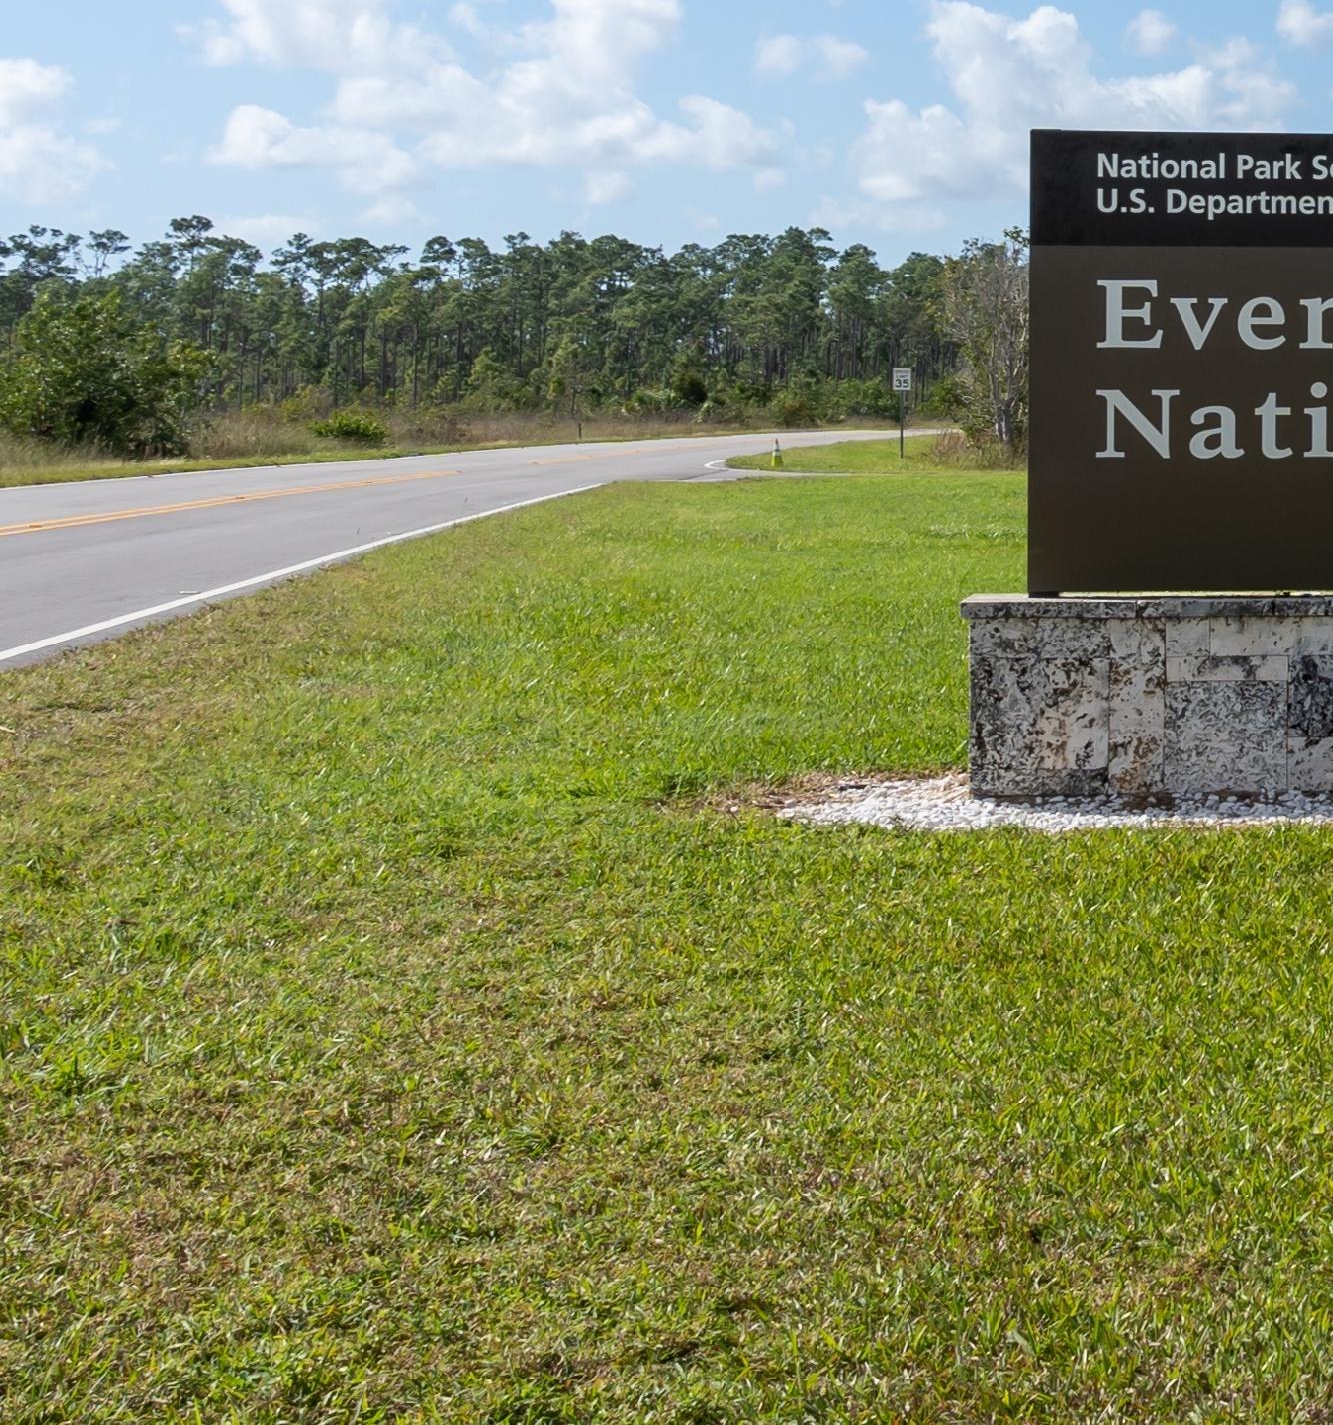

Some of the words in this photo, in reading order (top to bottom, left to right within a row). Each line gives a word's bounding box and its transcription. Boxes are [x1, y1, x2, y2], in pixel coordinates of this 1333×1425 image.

[1098, 153, 1226, 179] National
[1237, 154, 1303, 179] Park
[1097, 188, 1155, 214] U.S.
[895, 378, 909, 388] 35
